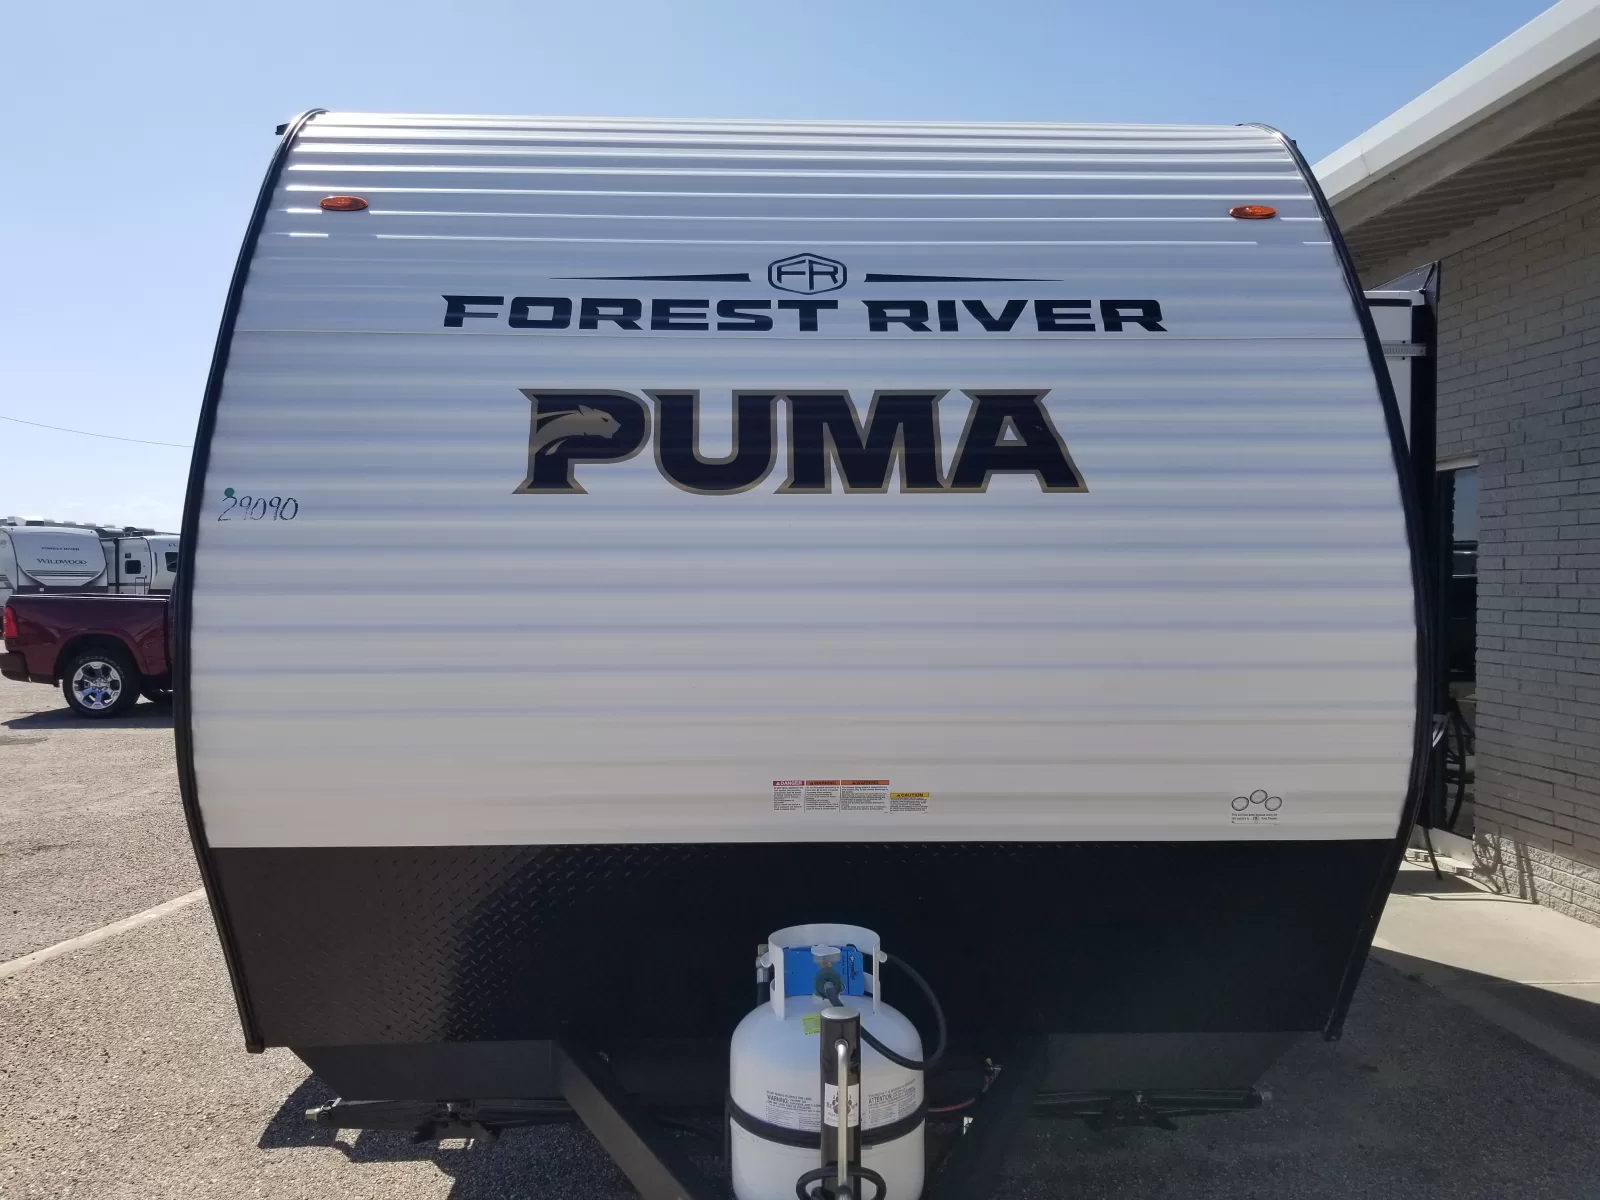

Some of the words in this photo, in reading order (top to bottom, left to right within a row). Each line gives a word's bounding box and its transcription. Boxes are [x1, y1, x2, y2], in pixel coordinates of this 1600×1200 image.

[774, 257, 840, 292] FR
[441, 295, 839, 332] FOREST
[860, 299, 1168, 332] RIVER
[511, 388, 1090, 495] PUMA
[217, 495, 299, 522] 29090
